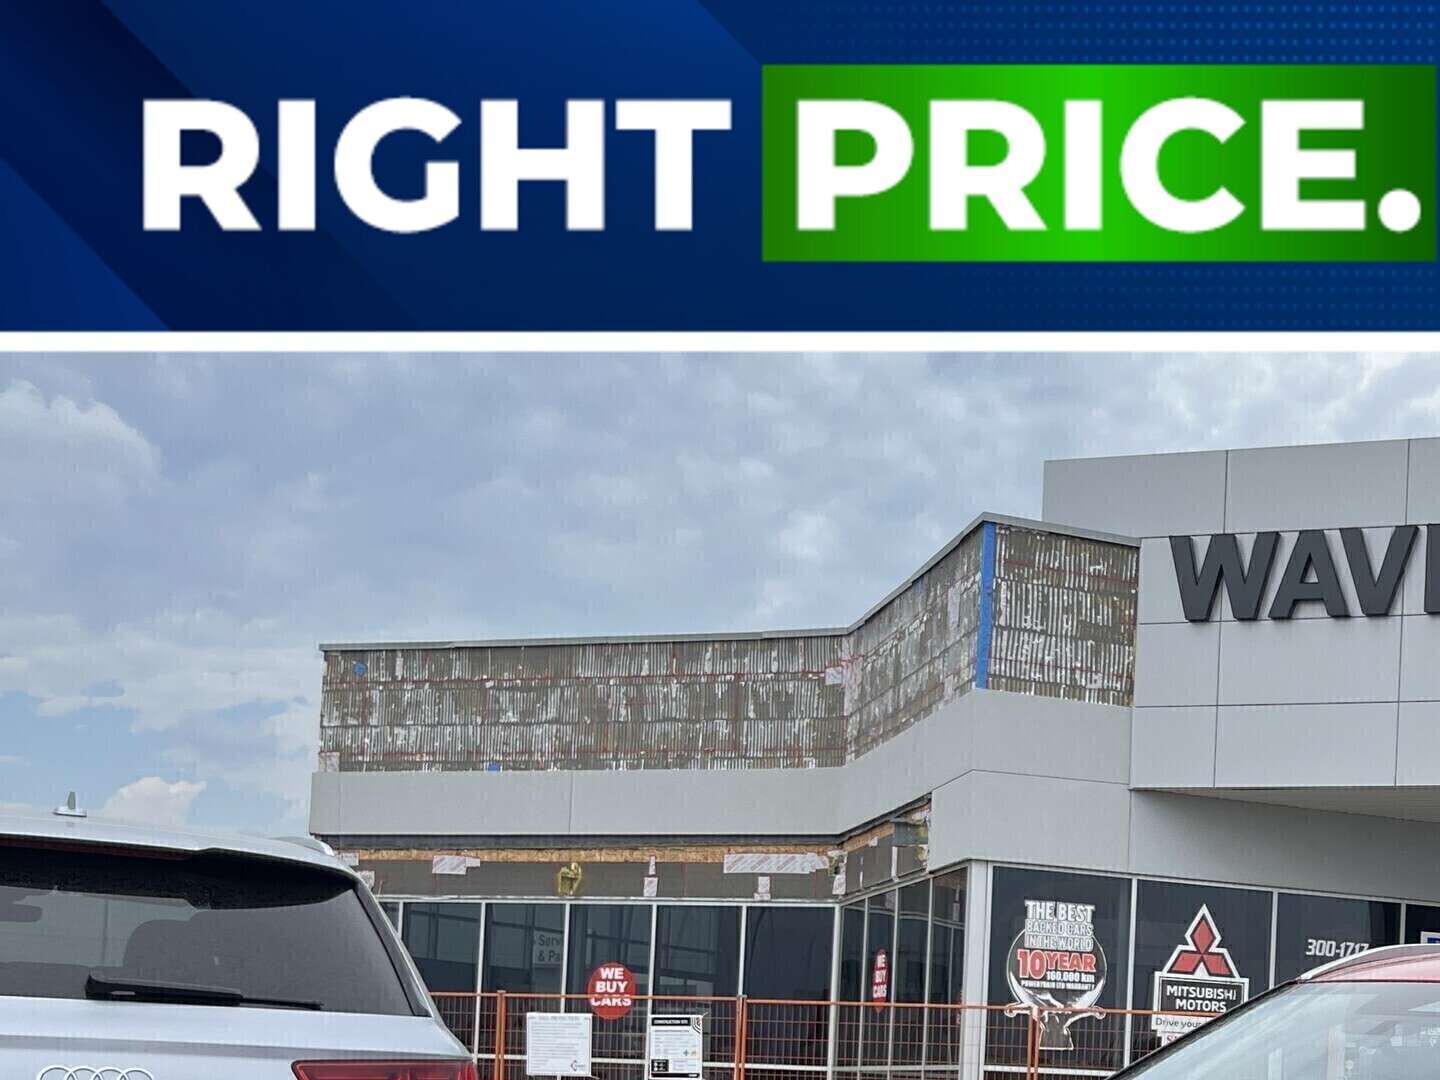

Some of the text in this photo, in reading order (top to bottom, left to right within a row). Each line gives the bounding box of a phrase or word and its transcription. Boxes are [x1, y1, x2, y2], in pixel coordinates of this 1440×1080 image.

[1024, 900, 1095, 922] THE BEST
[1025, 919, 1094, 936] BACKED CARS
[1025, 935, 1094, 951] IN THE WORLD
[1017, 949, 1096, 979] 10 YEAR
[600, 967, 624, 979] WE
[875, 970, 886, 982] BUY
[595, 981, 628, 992] BUY
[873, 985, 887, 997] CARS
[1166, 985, 1236, 1000] MITSUBISHI
[591, 994, 632, 1006] CARS
[1175, 999, 1227, 1012] MOTORS
[1155, 1018, 1202, 1029] Drive your
